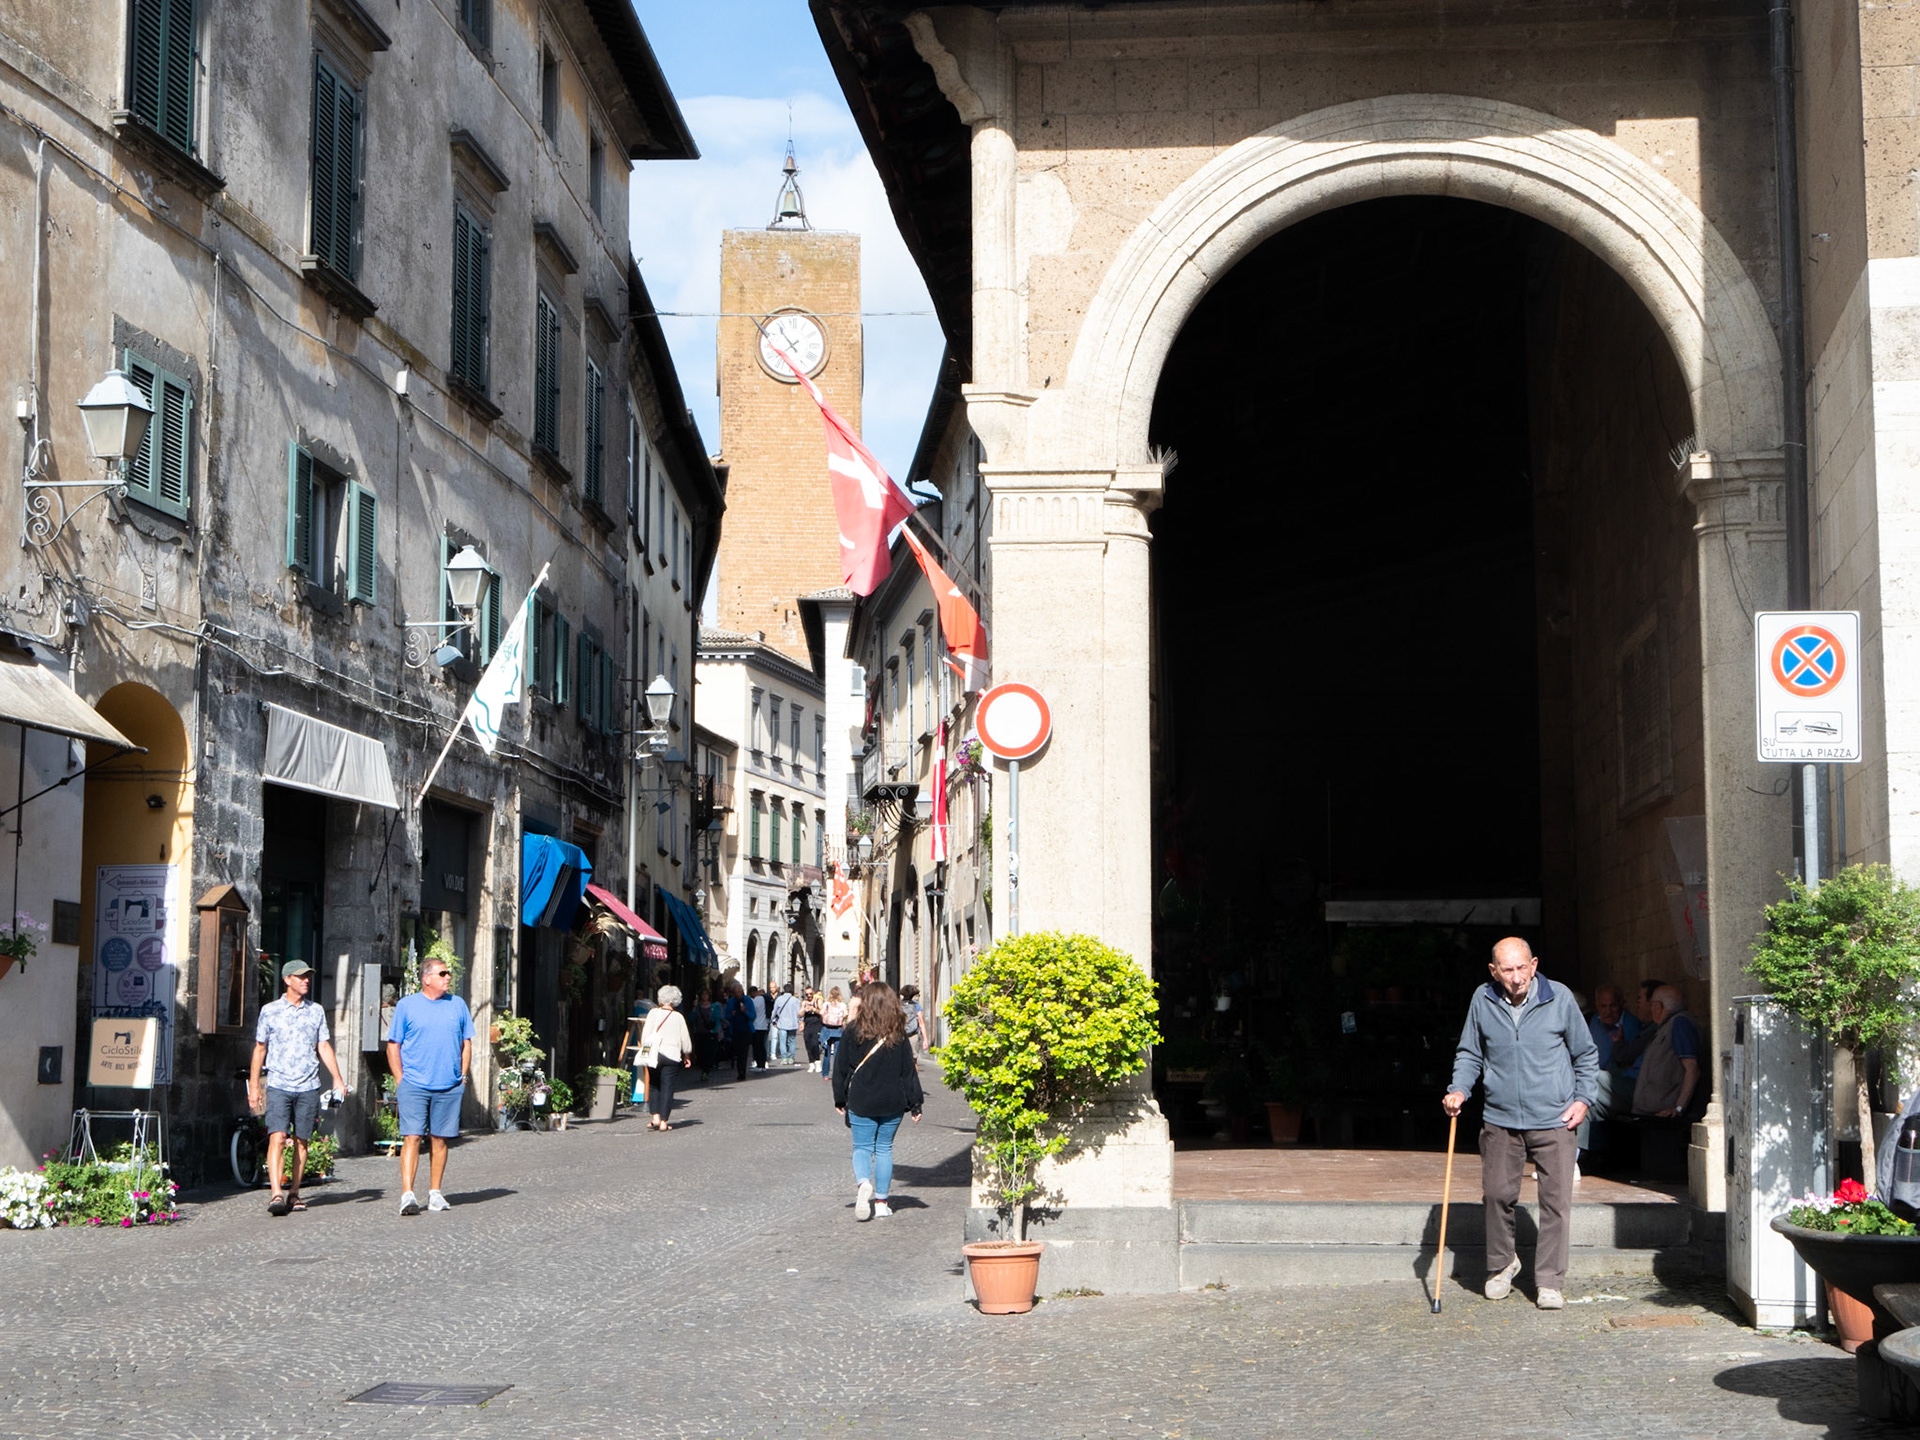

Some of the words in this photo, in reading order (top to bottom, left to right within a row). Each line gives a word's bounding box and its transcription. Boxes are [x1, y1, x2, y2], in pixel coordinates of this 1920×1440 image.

[1763, 737, 1776, 747] SU
[1766, 748, 1796, 758] TUTTA
[1800, 748, 1813, 758] LA
[1817, 748, 1852, 758] PIAZZA
[100, 1045, 144, 1055] CicloStile
